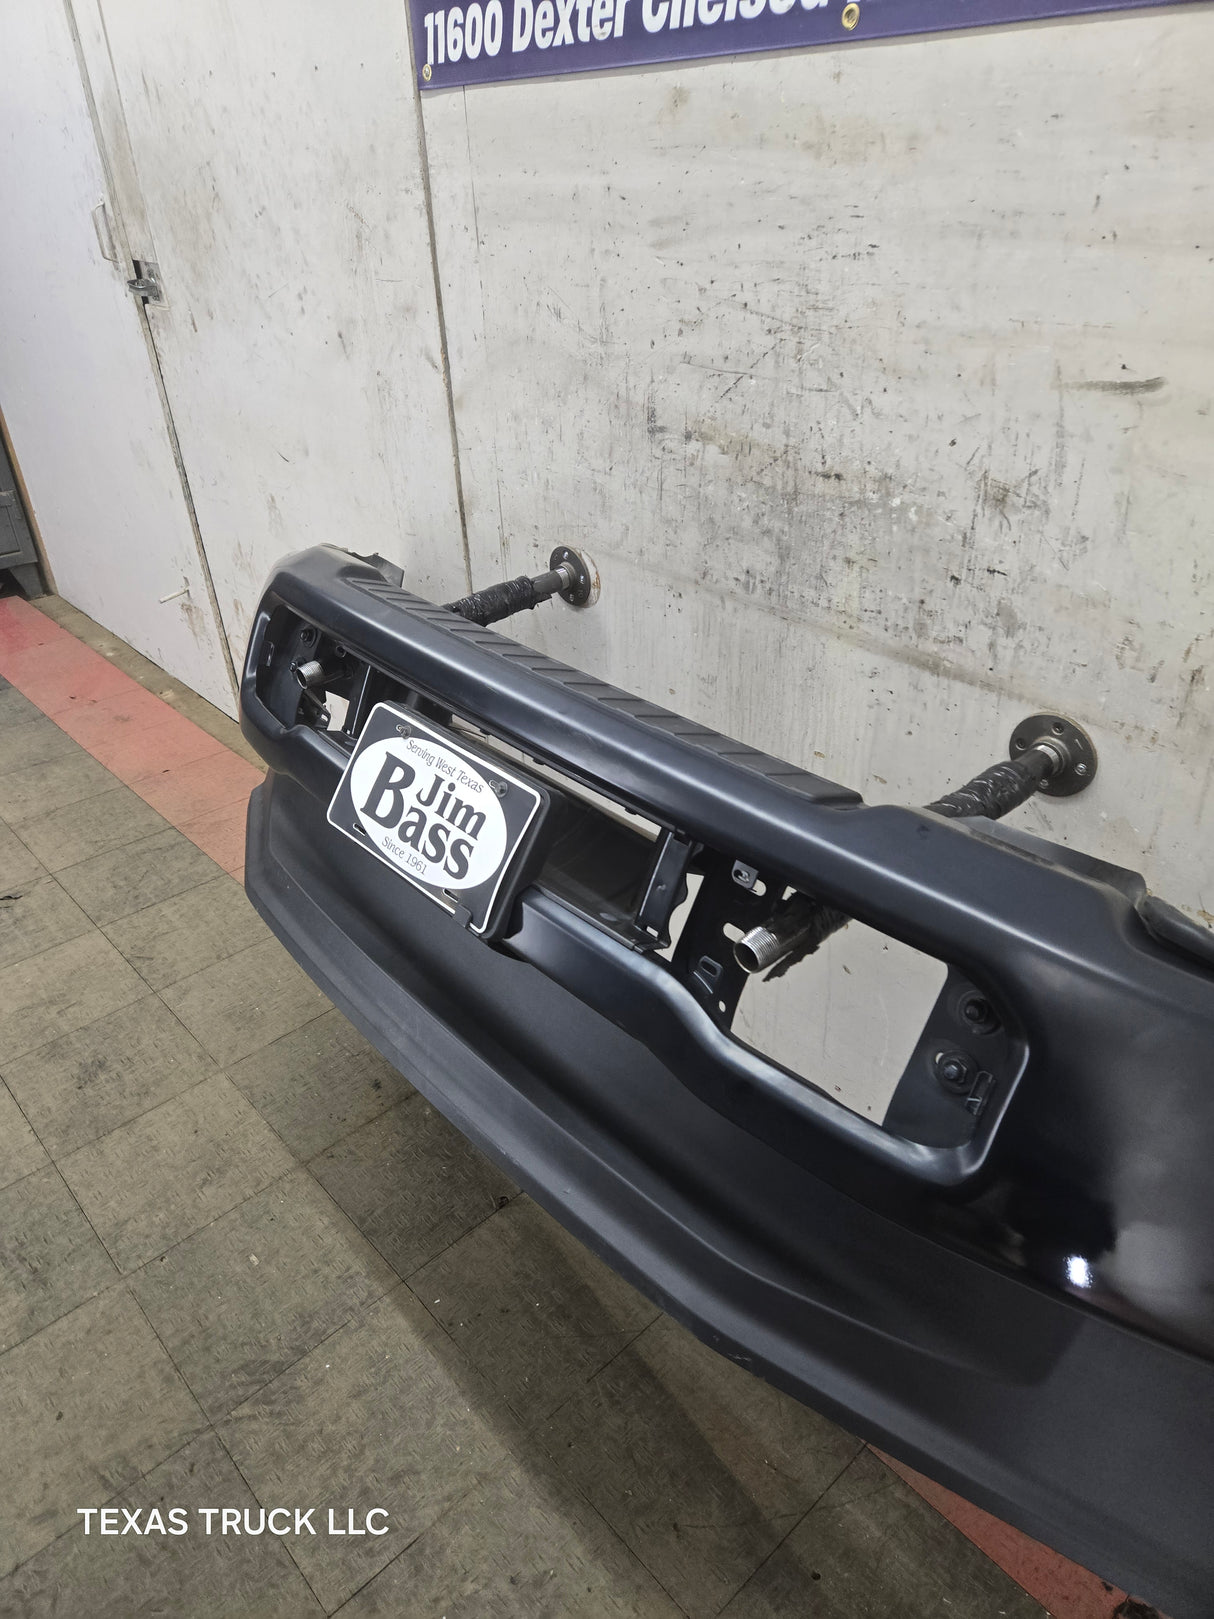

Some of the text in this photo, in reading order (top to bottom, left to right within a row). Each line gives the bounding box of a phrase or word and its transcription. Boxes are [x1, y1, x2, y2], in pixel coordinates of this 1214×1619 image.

[424, 0, 504, 65] 11600
[512, 0, 630, 53] Dexter
[406, 739, 484, 794] Serving West Texas
[360, 751, 475, 880] Bass
[415, 773, 487, 841] Jim
[381, 835, 427, 876] Since 1961
